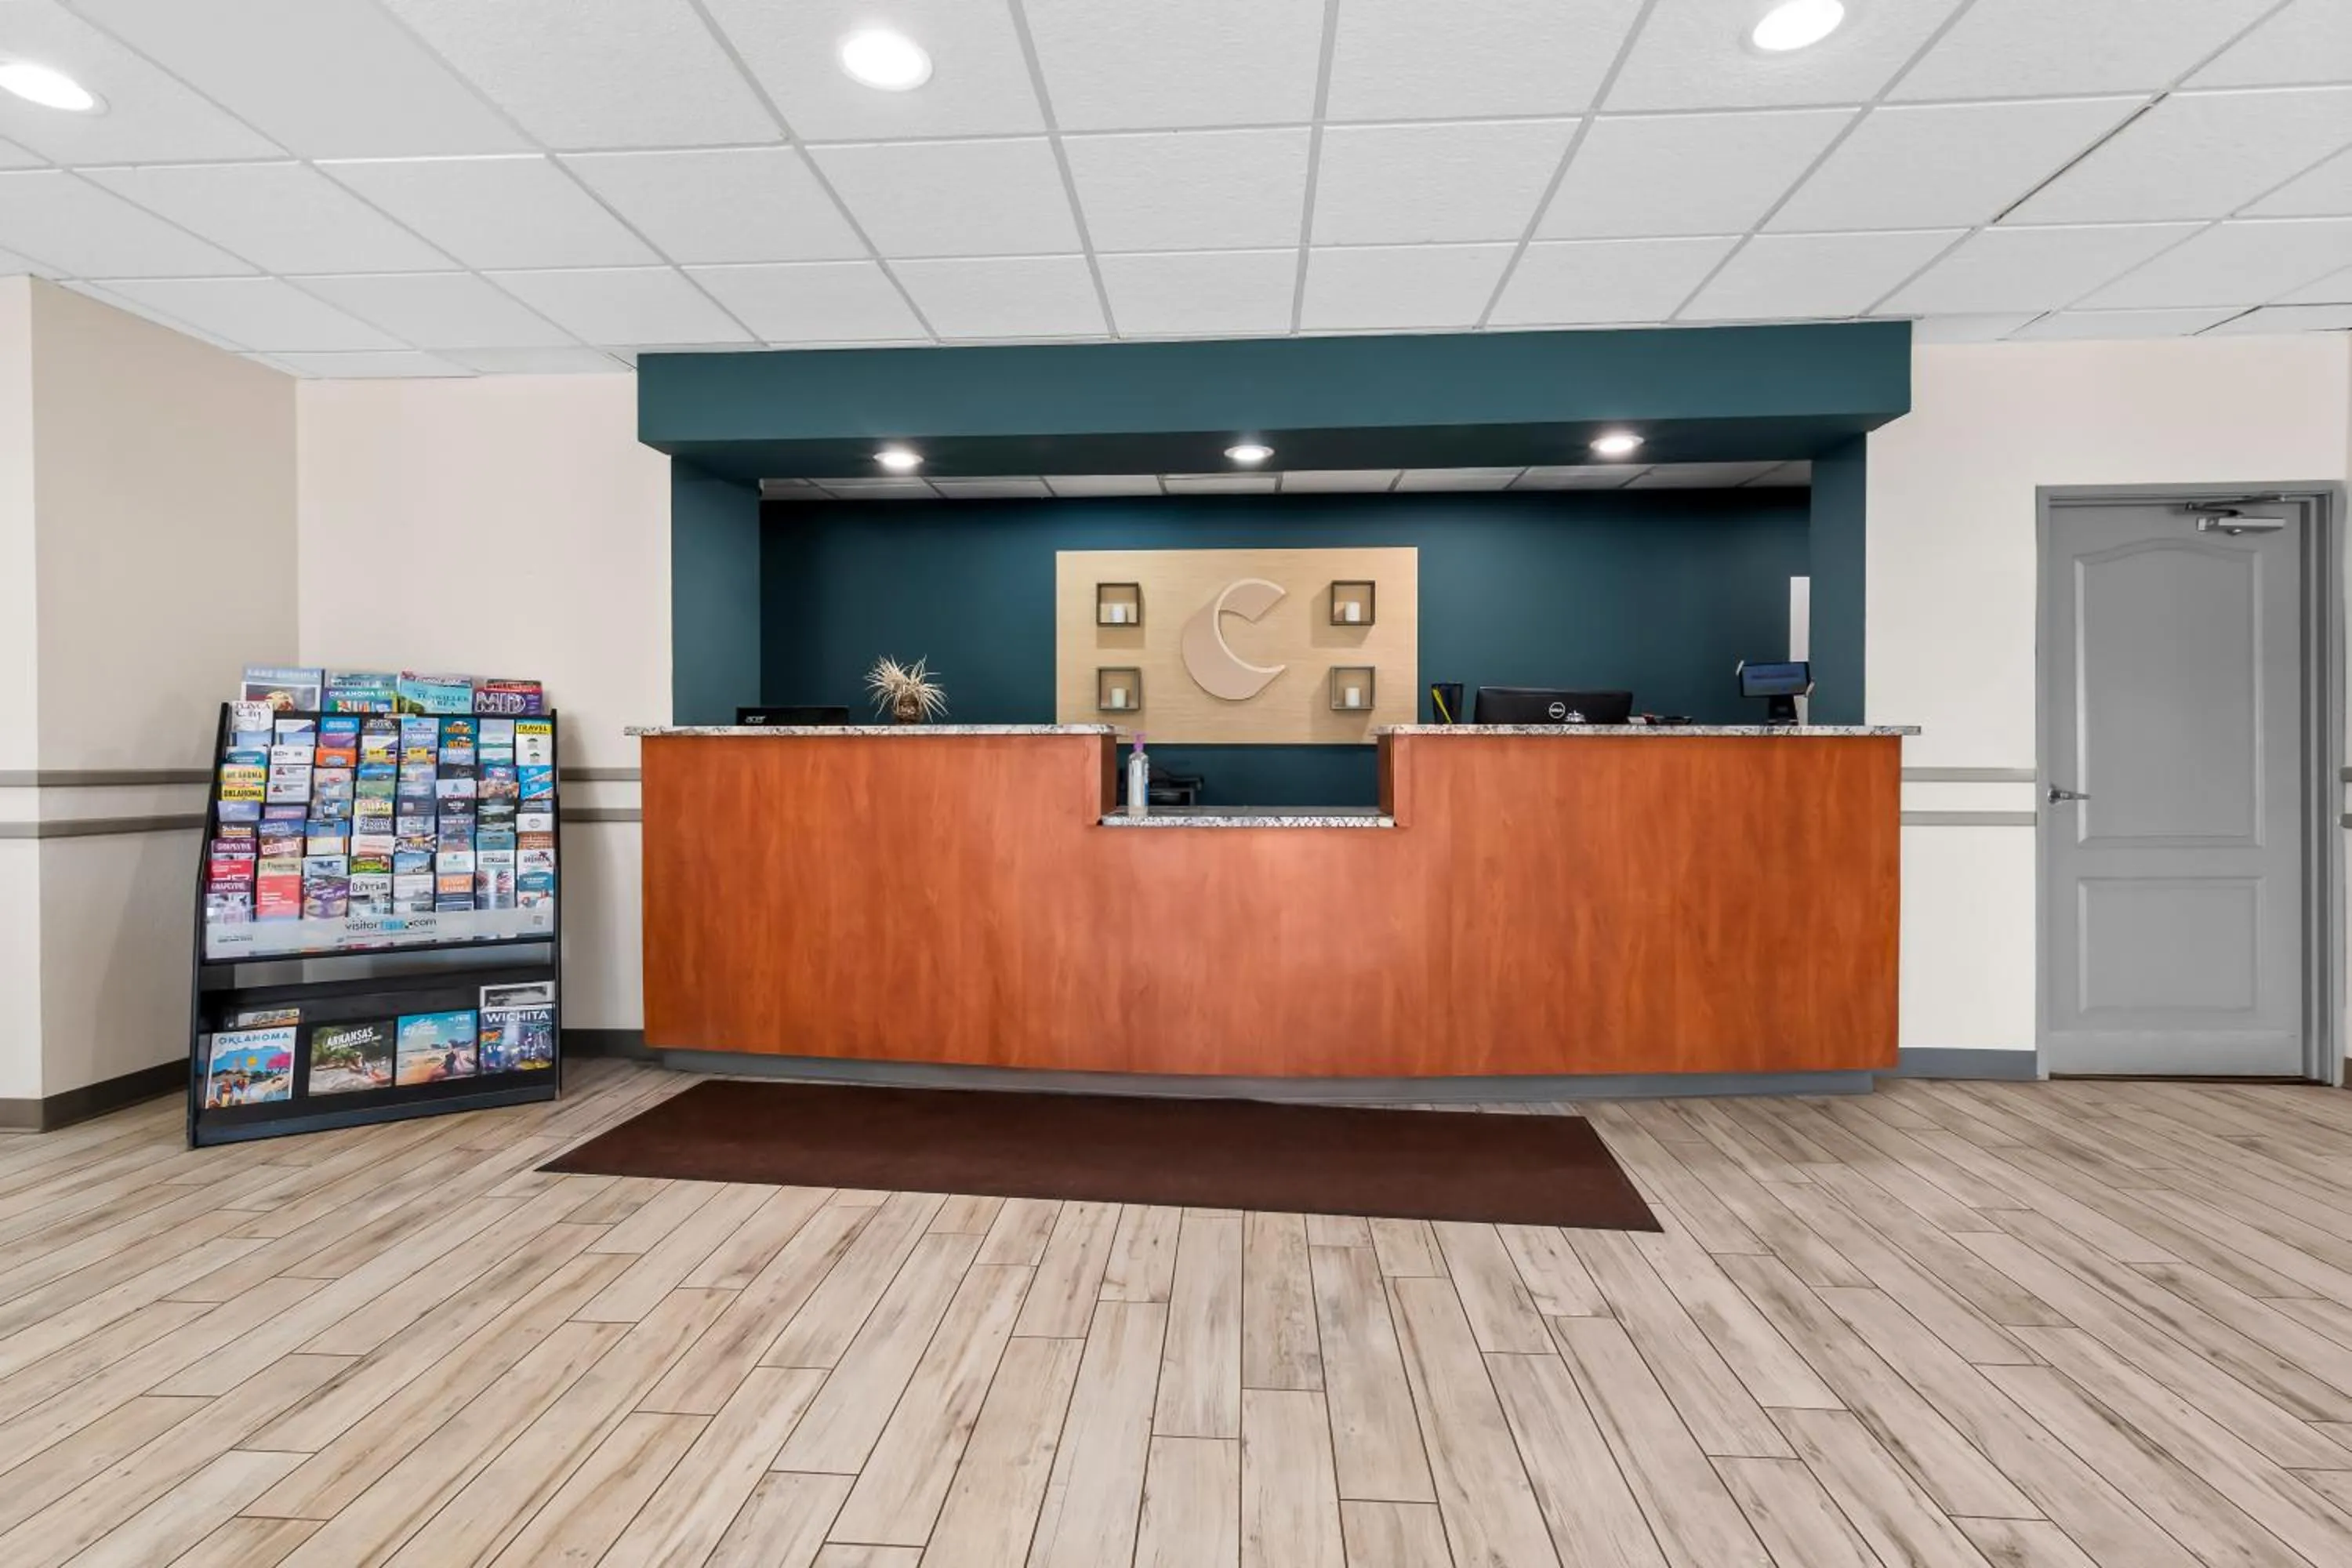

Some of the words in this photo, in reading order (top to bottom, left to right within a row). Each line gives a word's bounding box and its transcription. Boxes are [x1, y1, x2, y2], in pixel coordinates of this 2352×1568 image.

[517, 724, 548, 732] TRAVEL
[223, 789, 263, 797] OKLAHOMA
[486, 1010, 549, 1023] WICHITA
[218, 1032, 290, 1045] OKLAHOMA
[326, 1025, 374, 1047] ARKANSAS
